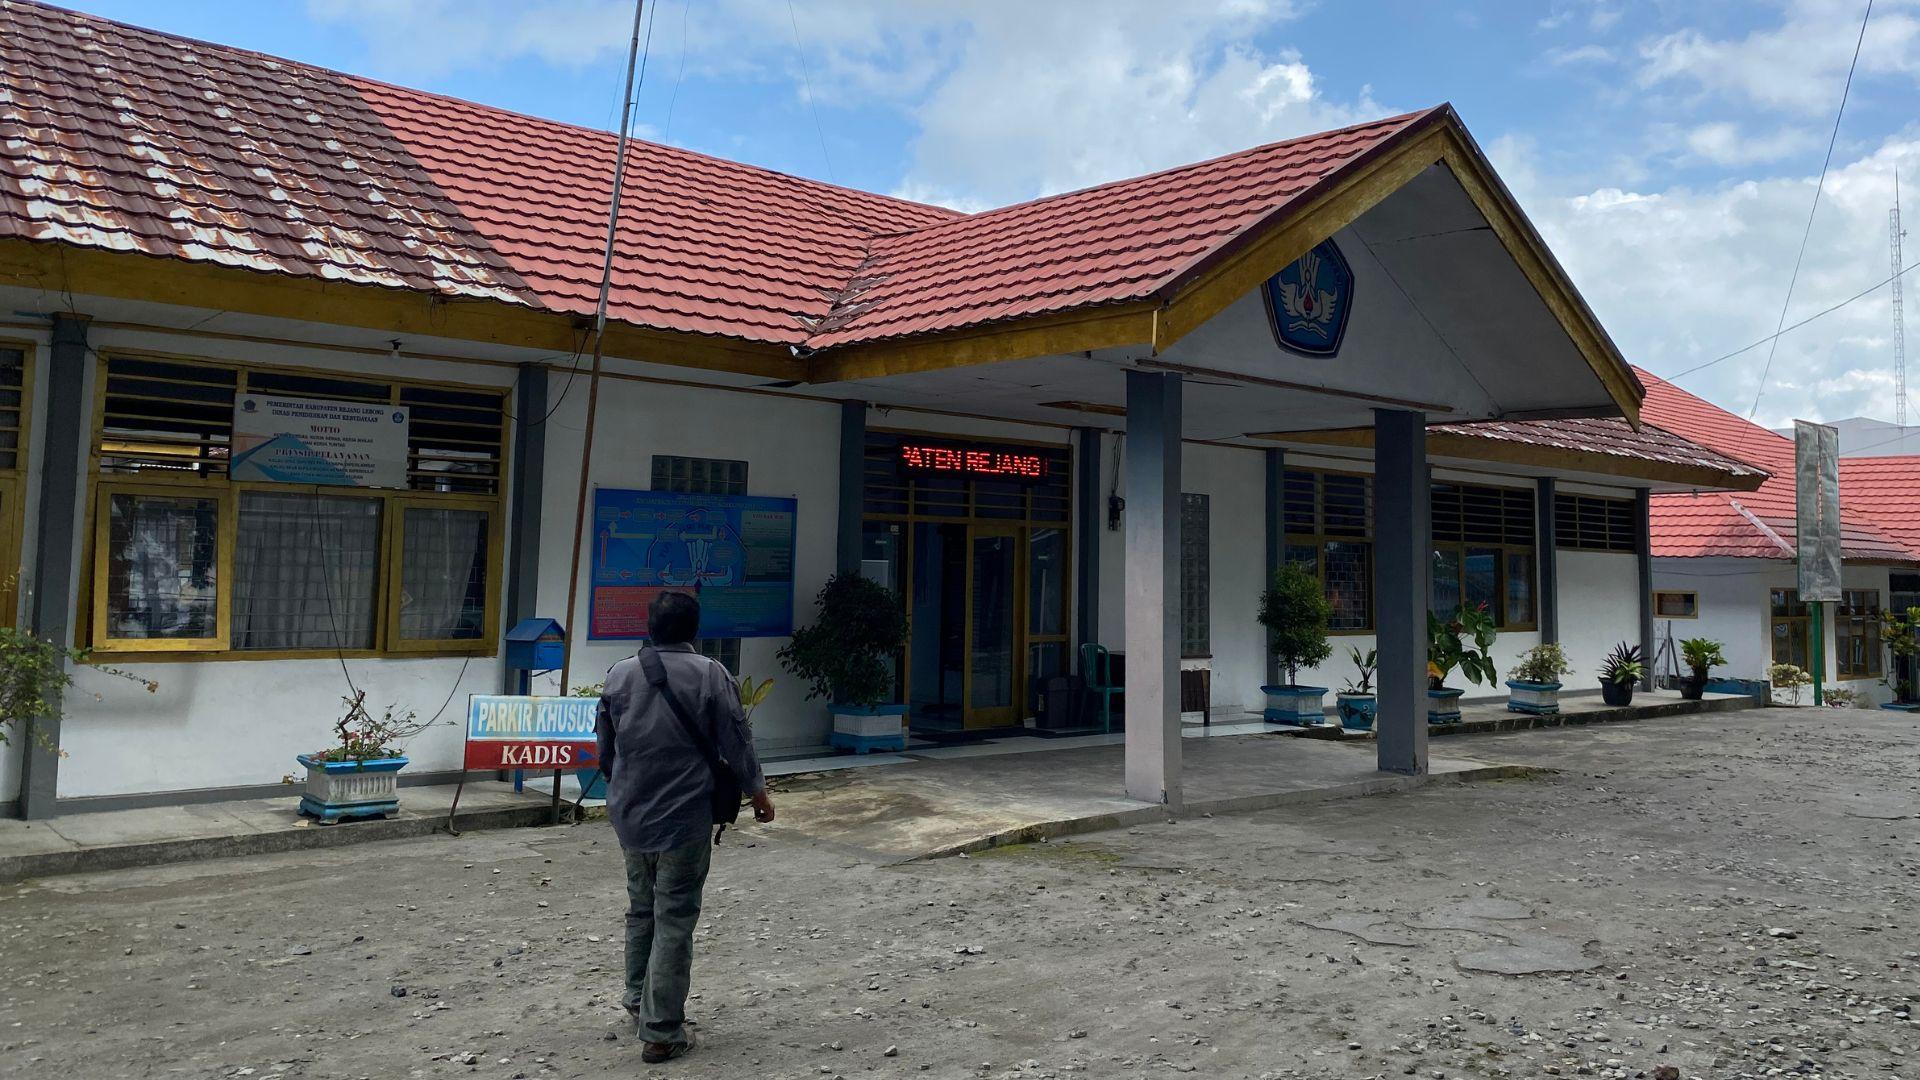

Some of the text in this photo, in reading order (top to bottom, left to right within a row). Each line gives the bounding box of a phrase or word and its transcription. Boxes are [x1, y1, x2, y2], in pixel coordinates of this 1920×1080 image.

[305, 403, 338, 411] KABUPATEN
[310, 425, 340, 433] MOTTO
[966, 451, 1040, 476] REJANG
[478, 702, 597, 733] PARKIR KHUSUS
[501, 745, 572, 765] KADIS
